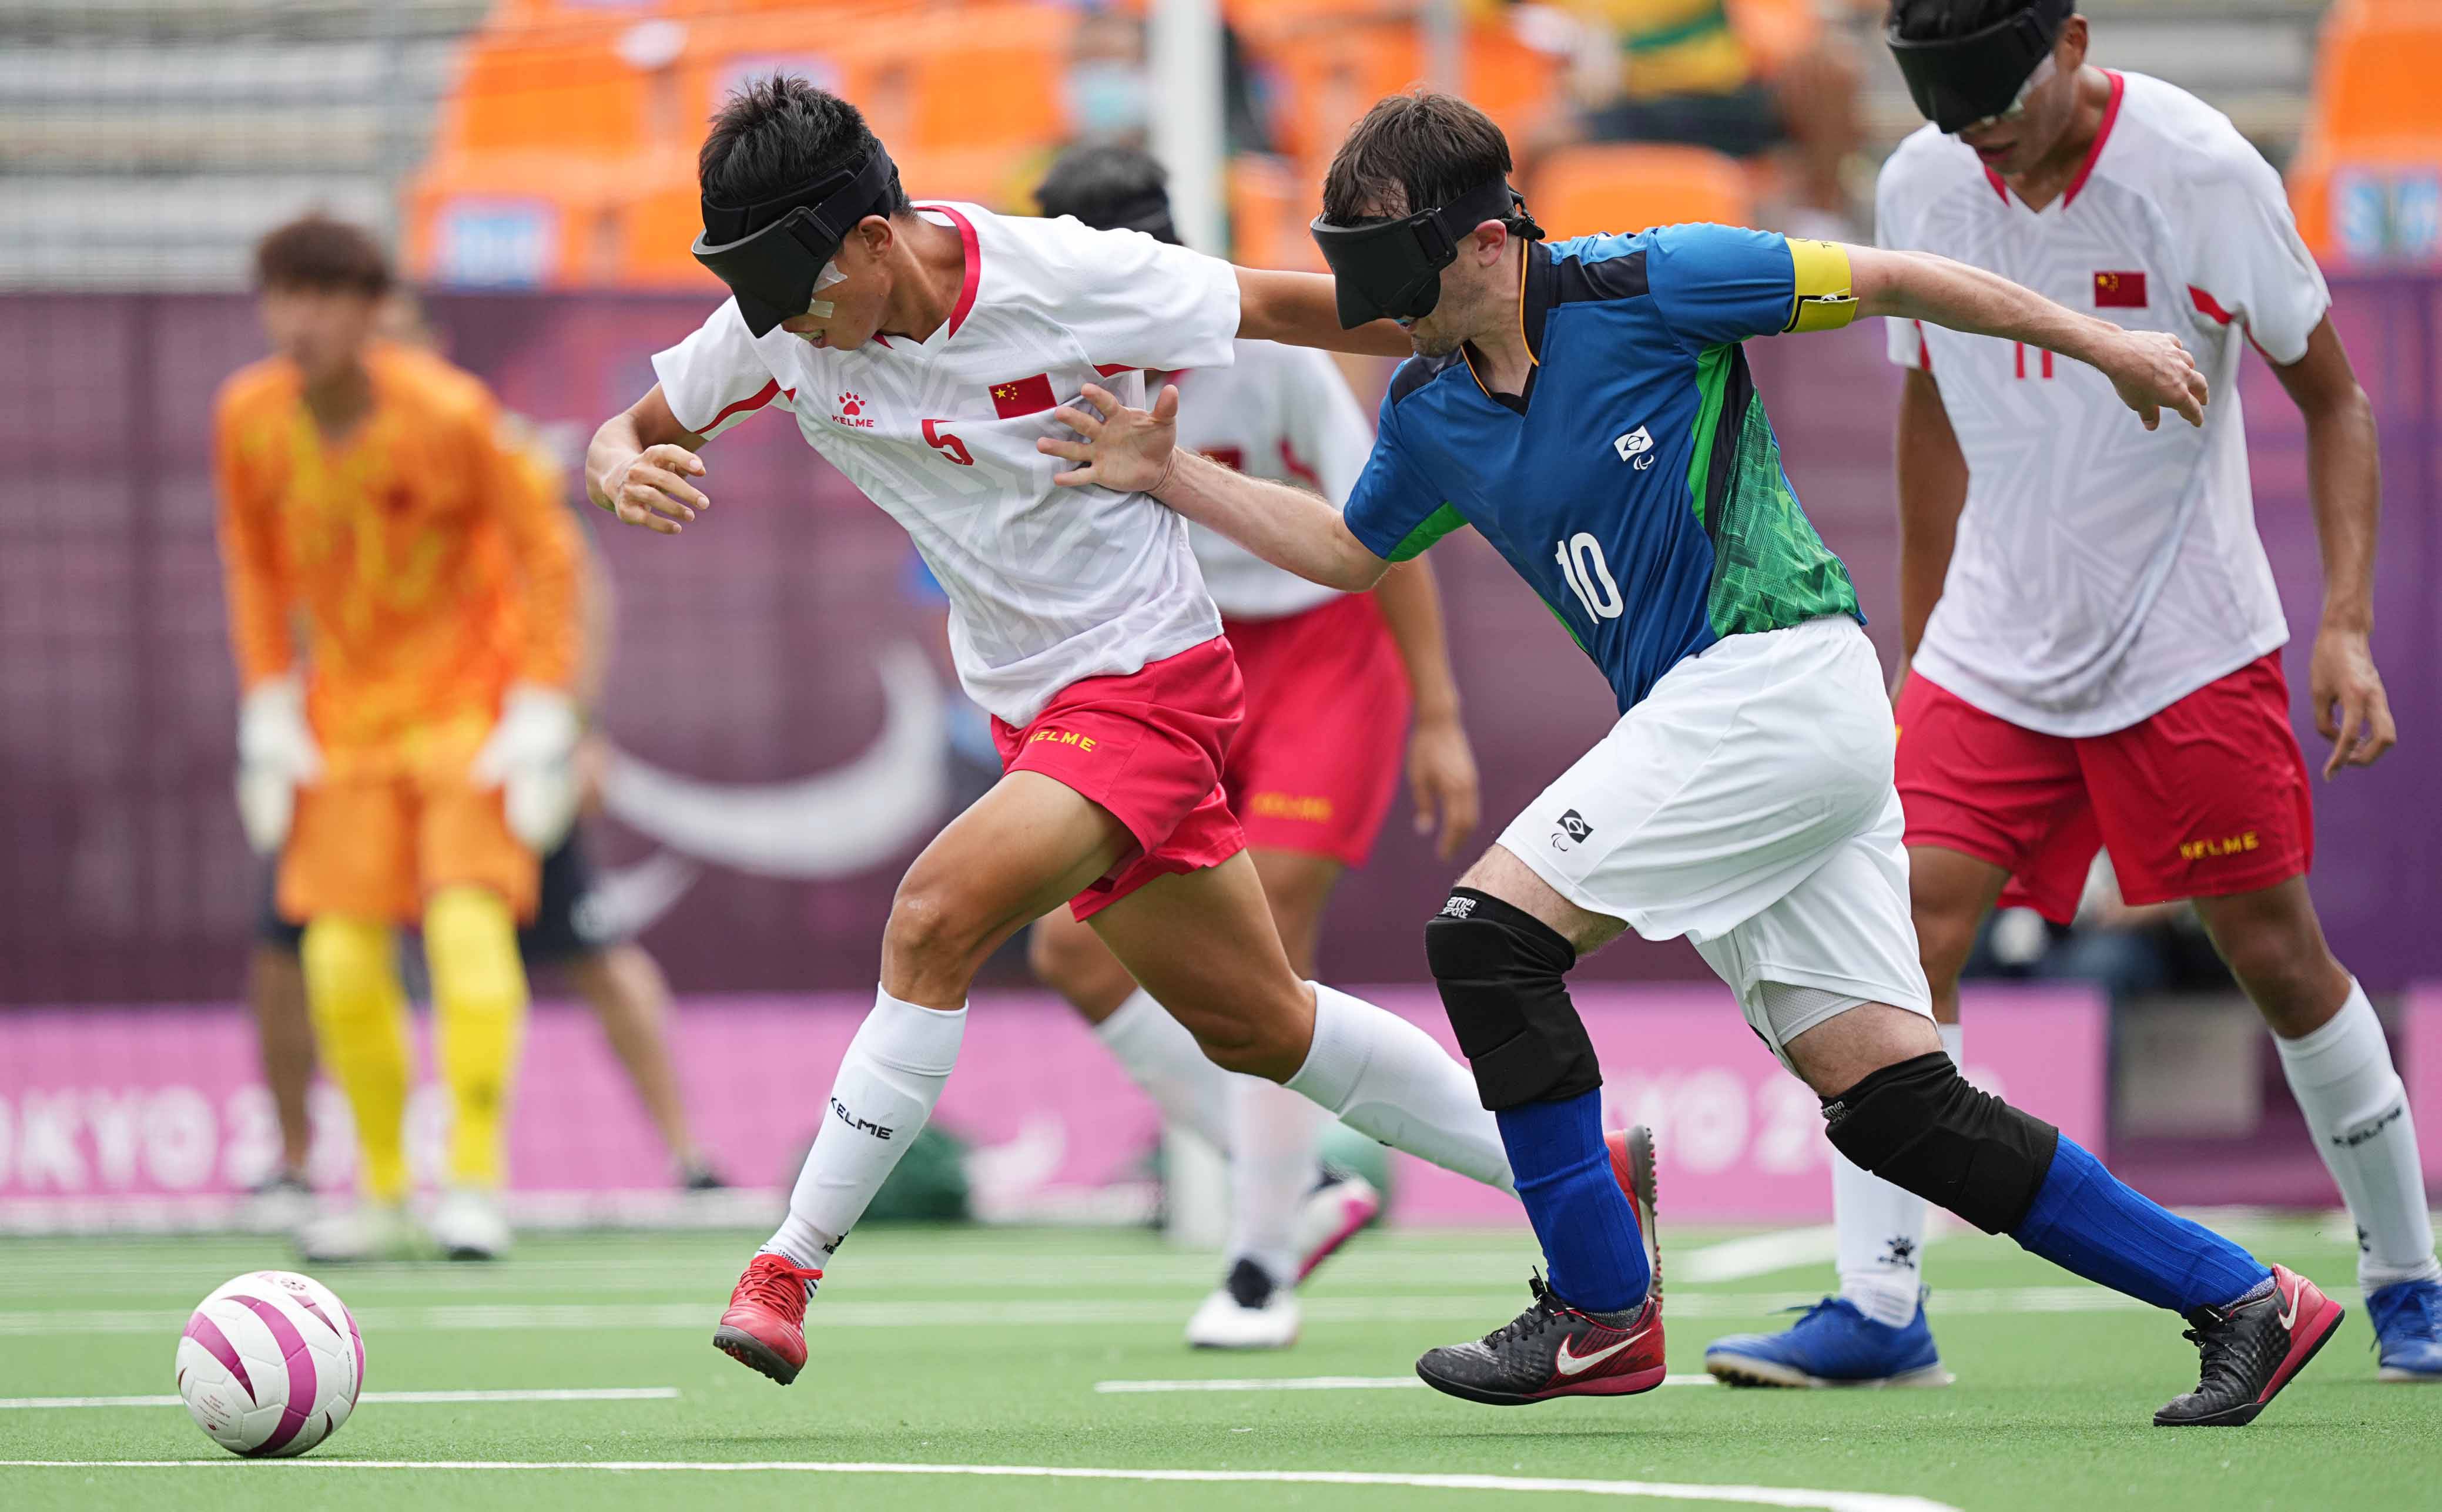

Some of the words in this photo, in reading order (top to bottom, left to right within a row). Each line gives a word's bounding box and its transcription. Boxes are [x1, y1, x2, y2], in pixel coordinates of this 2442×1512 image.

[832, 415, 874, 427] KELME
[922, 419, 974, 465] 5
[1555, 532, 1623, 624] 10
[0, 1085, 217, 1192] KYO
